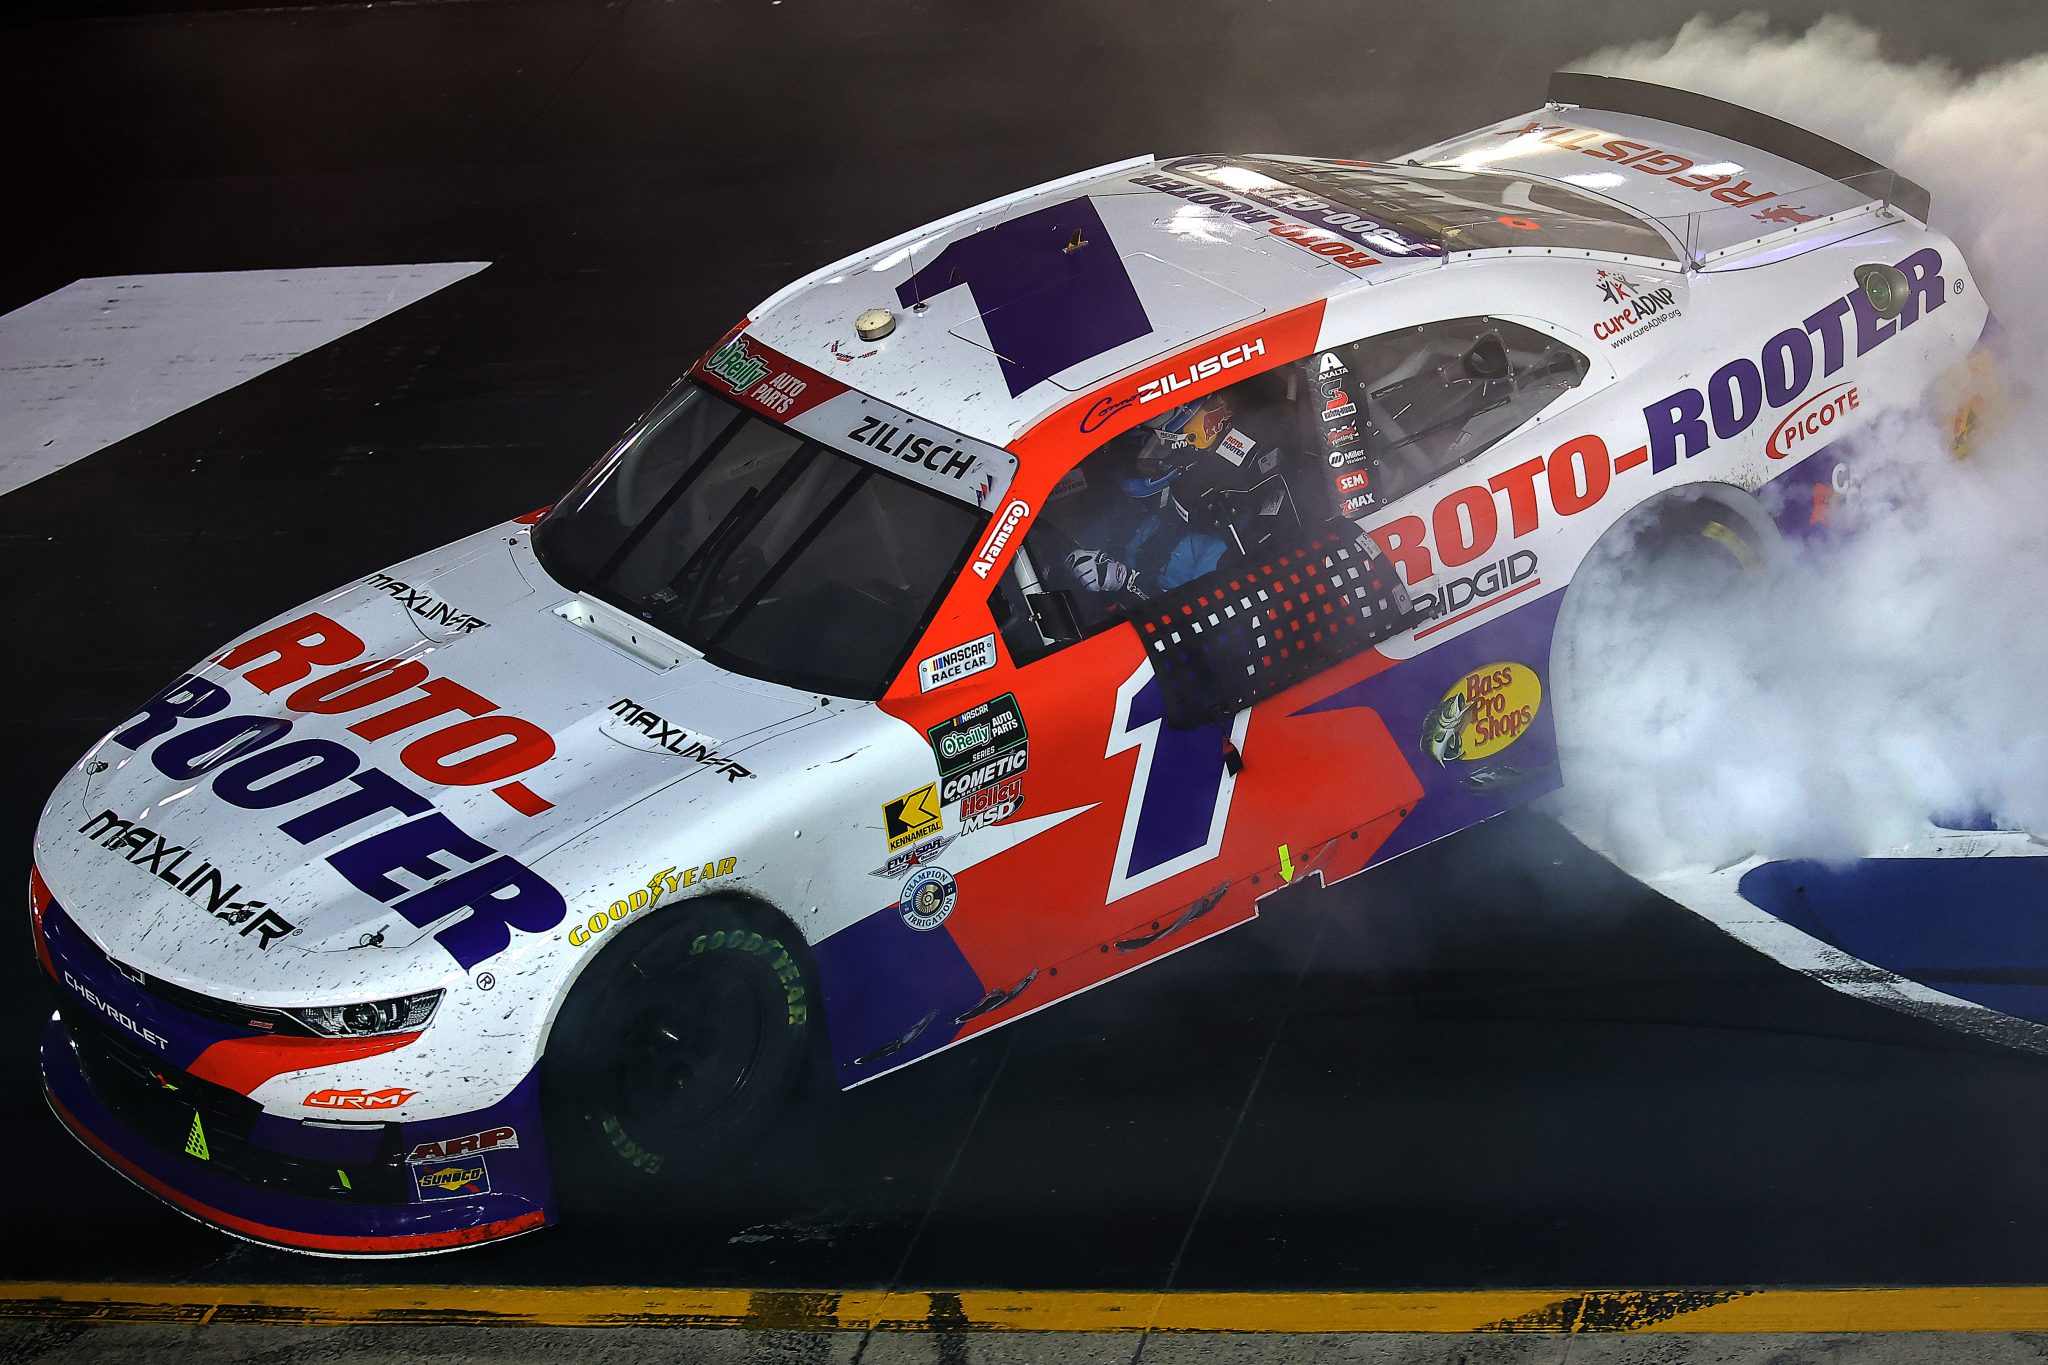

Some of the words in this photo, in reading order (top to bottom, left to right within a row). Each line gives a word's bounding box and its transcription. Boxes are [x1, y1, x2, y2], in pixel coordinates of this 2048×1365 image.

[1129, 174, 1382, 269] ROTO-ROOTER
[895, 195, 1153, 399] 1
[1594, 287, 1675, 340] cureADNP
[1611, 309, 1681, 349] www.cureADNP.org
[703, 338, 772, 394] O'Reilly
[769, 372, 807, 396] AUTO
[1137, 338, 1266, 404] ZILISCH
[1319, 367, 1349, 381] AXALTA
[750, 383, 795, 414] PARTS
[1368, 248, 1946, 586] ROTO-ROOTER
[1785, 387, 1860, 449] PICOTE
[847, 415, 976, 480] ZILISCH
[1222, 440, 1245, 458] ROOTER
[1344, 449, 1365, 461] Miller
[1340, 474, 1365, 490] SEM
[972, 503, 1026, 579] Aramsco
[362, 573, 487, 633] MAXLINER
[1411, 550, 1538, 629] RIDGID
[932, 665, 961, 684] RACE
[965, 656, 987, 671] CAR
[943, 642, 985, 667] NASCAR
[1466, 667, 1512, 702] Bass
[209, 612, 556, 817] ROTO-
[962, 704, 989, 723] NASCAR
[992, 711, 1013, 728] AUTO
[1470, 694, 1506, 723] Pro
[1475, 705, 1532, 747] Shops
[607, 698, 751, 783] MAXLINER
[942, 726, 988, 757] O'Reilly
[992, 719, 1018, 738] PARTS
[972, 746, 995, 762] SERIES
[944, 749, 1026, 799] COMETIC
[1104, 653, 1253, 904] 1
[961, 778, 1023, 820] Holley
[110, 672, 567, 973] ROOTER
[890, 821, 942, 850] KENNAMETAL
[961, 802, 1015, 836] MSD
[887, 851, 912, 871] FIVE
[915, 839, 944, 856] STAR
[78, 809, 296, 950] MAXLINER
[904, 870, 948, 898] CHAMPION
[568, 857, 737, 946] GOODYEAR
[908, 898, 953, 927] IRRIGATION
[64, 970, 168, 1050] CHEVROLET
[309, 1093, 400, 1110] JRM
[411, 1127, 515, 1161] ARP
